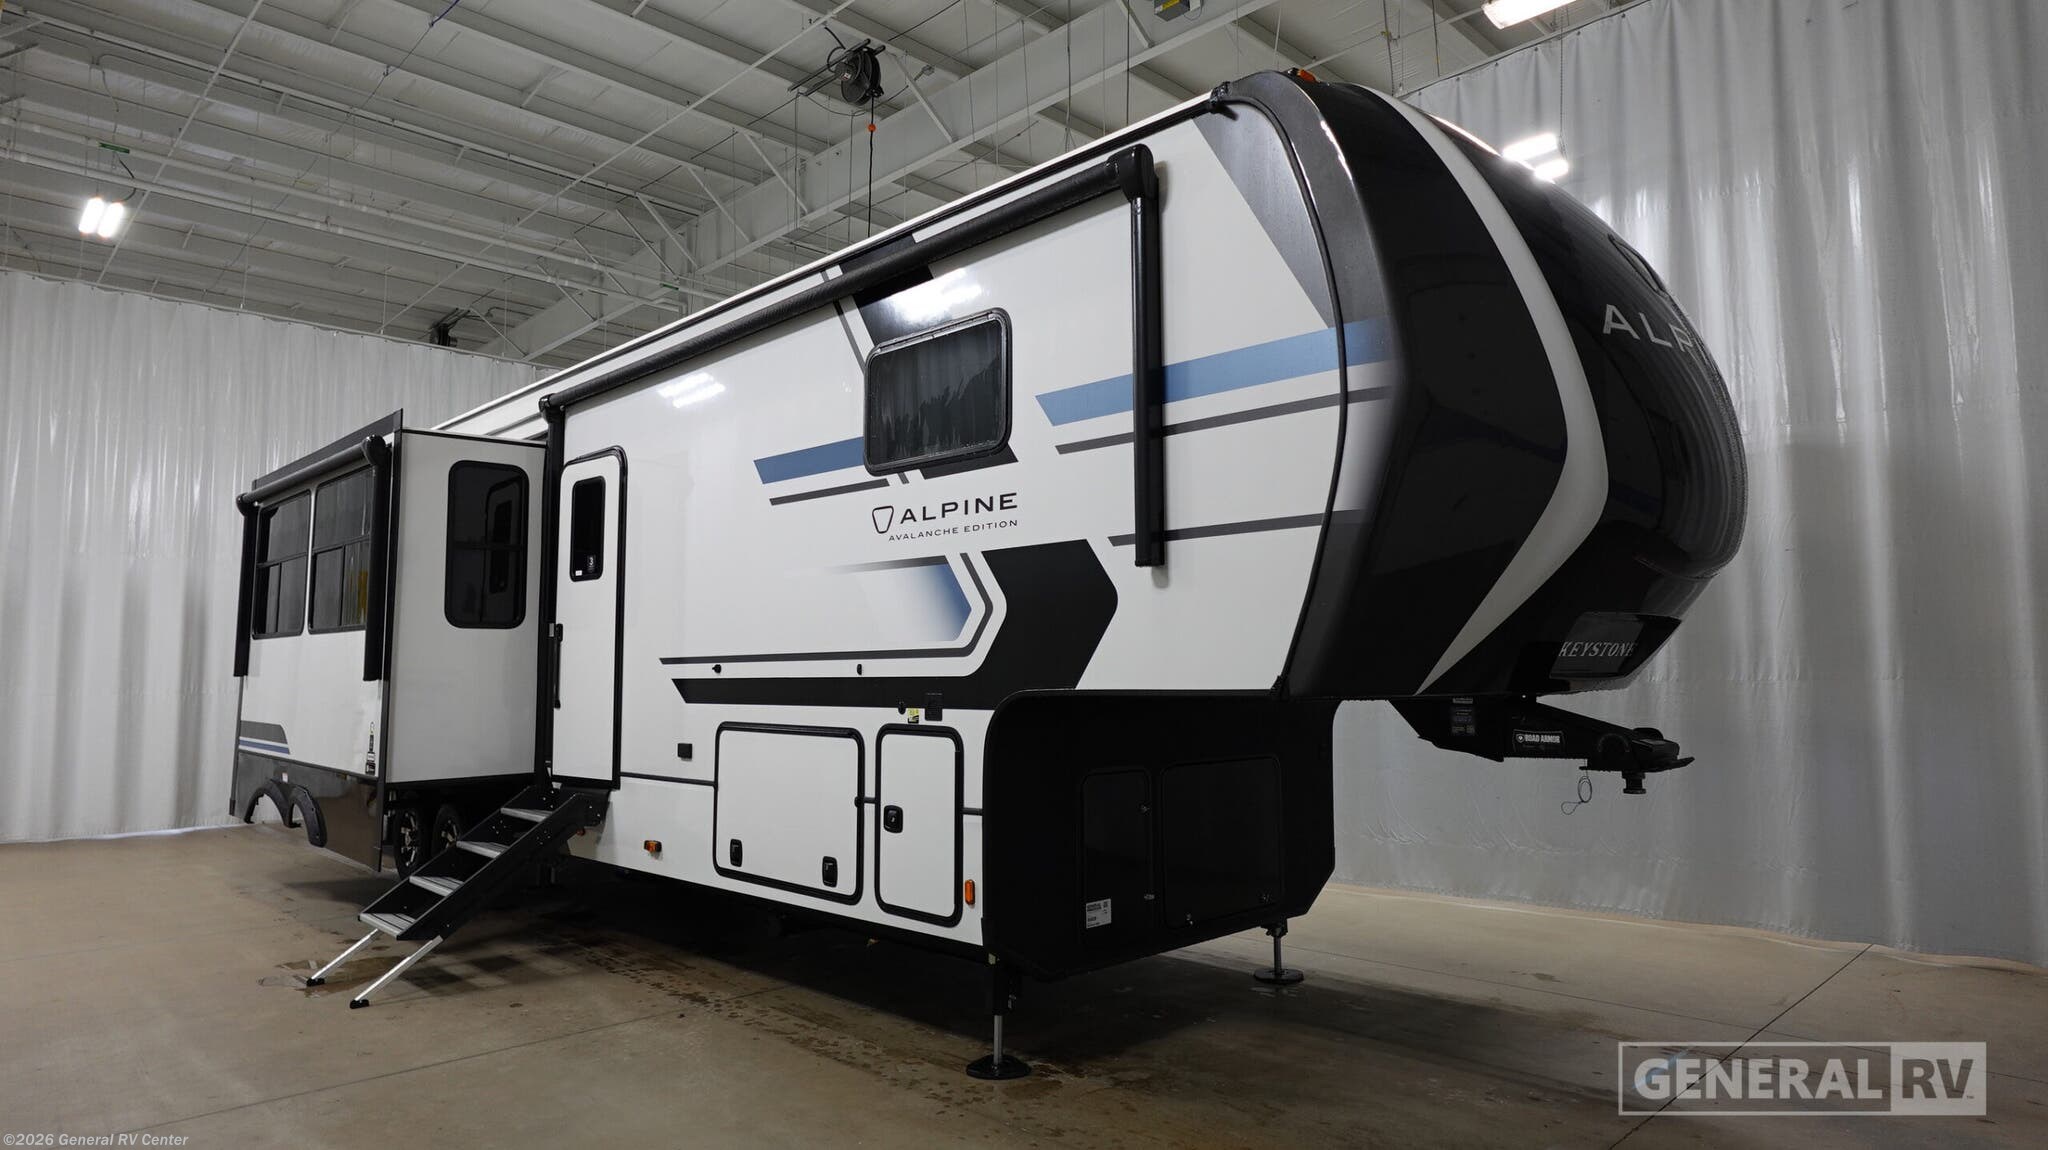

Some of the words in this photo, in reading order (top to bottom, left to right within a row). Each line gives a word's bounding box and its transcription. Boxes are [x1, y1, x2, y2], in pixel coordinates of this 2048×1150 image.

[900, 492, 1018, 525] ALPINE
[888, 526, 959, 542] AVALANCHE
[963, 519, 1018, 533] EDITION
